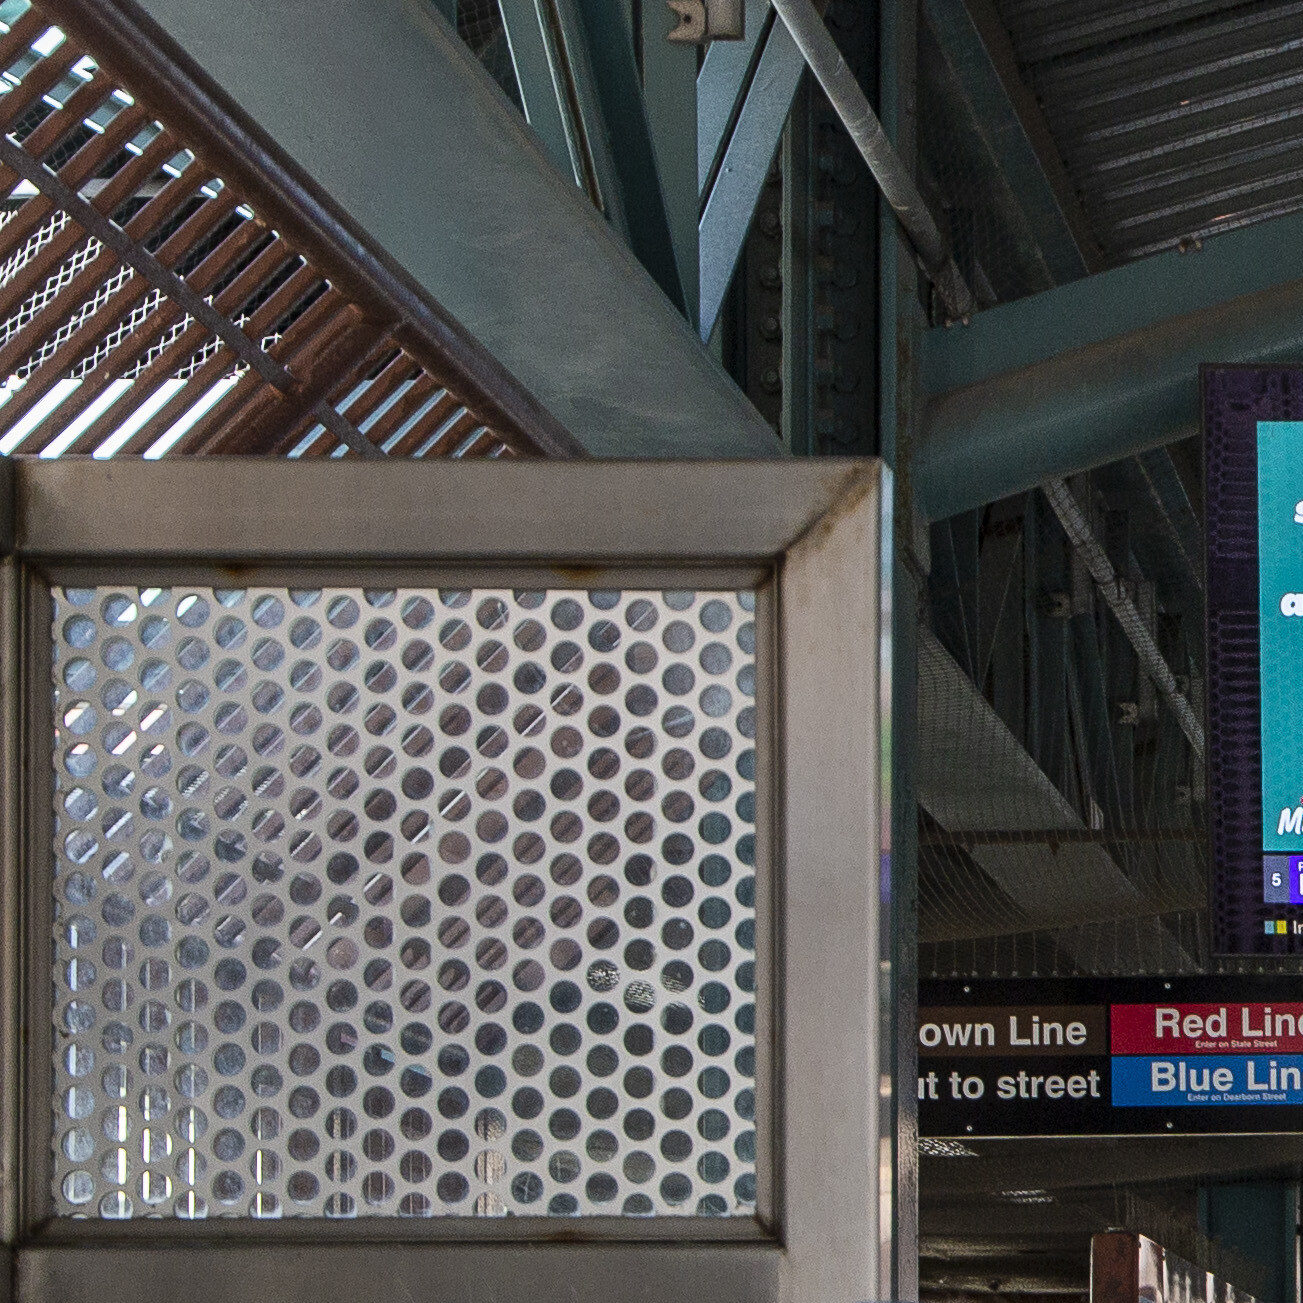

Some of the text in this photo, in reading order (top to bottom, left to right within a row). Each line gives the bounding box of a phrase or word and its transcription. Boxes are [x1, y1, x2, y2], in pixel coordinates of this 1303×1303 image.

[1272, 873, 1282, 886] 5
[1010, 1016, 1086, 1045] Line
[1155, 1008, 1227, 1038] Red
[1195, 1040, 1216, 1048] Enter
[1231, 1040, 1251, 1048] State
[1254, 1040, 1277, 1048] Street
[949, 1072, 984, 1099] to
[997, 1070, 1100, 1098] street
[1151, 1061, 1233, 1091] Blue
[1187, 1093, 1208, 1101] Enter
[1224, 1093, 1260, 1101] Dearborn
